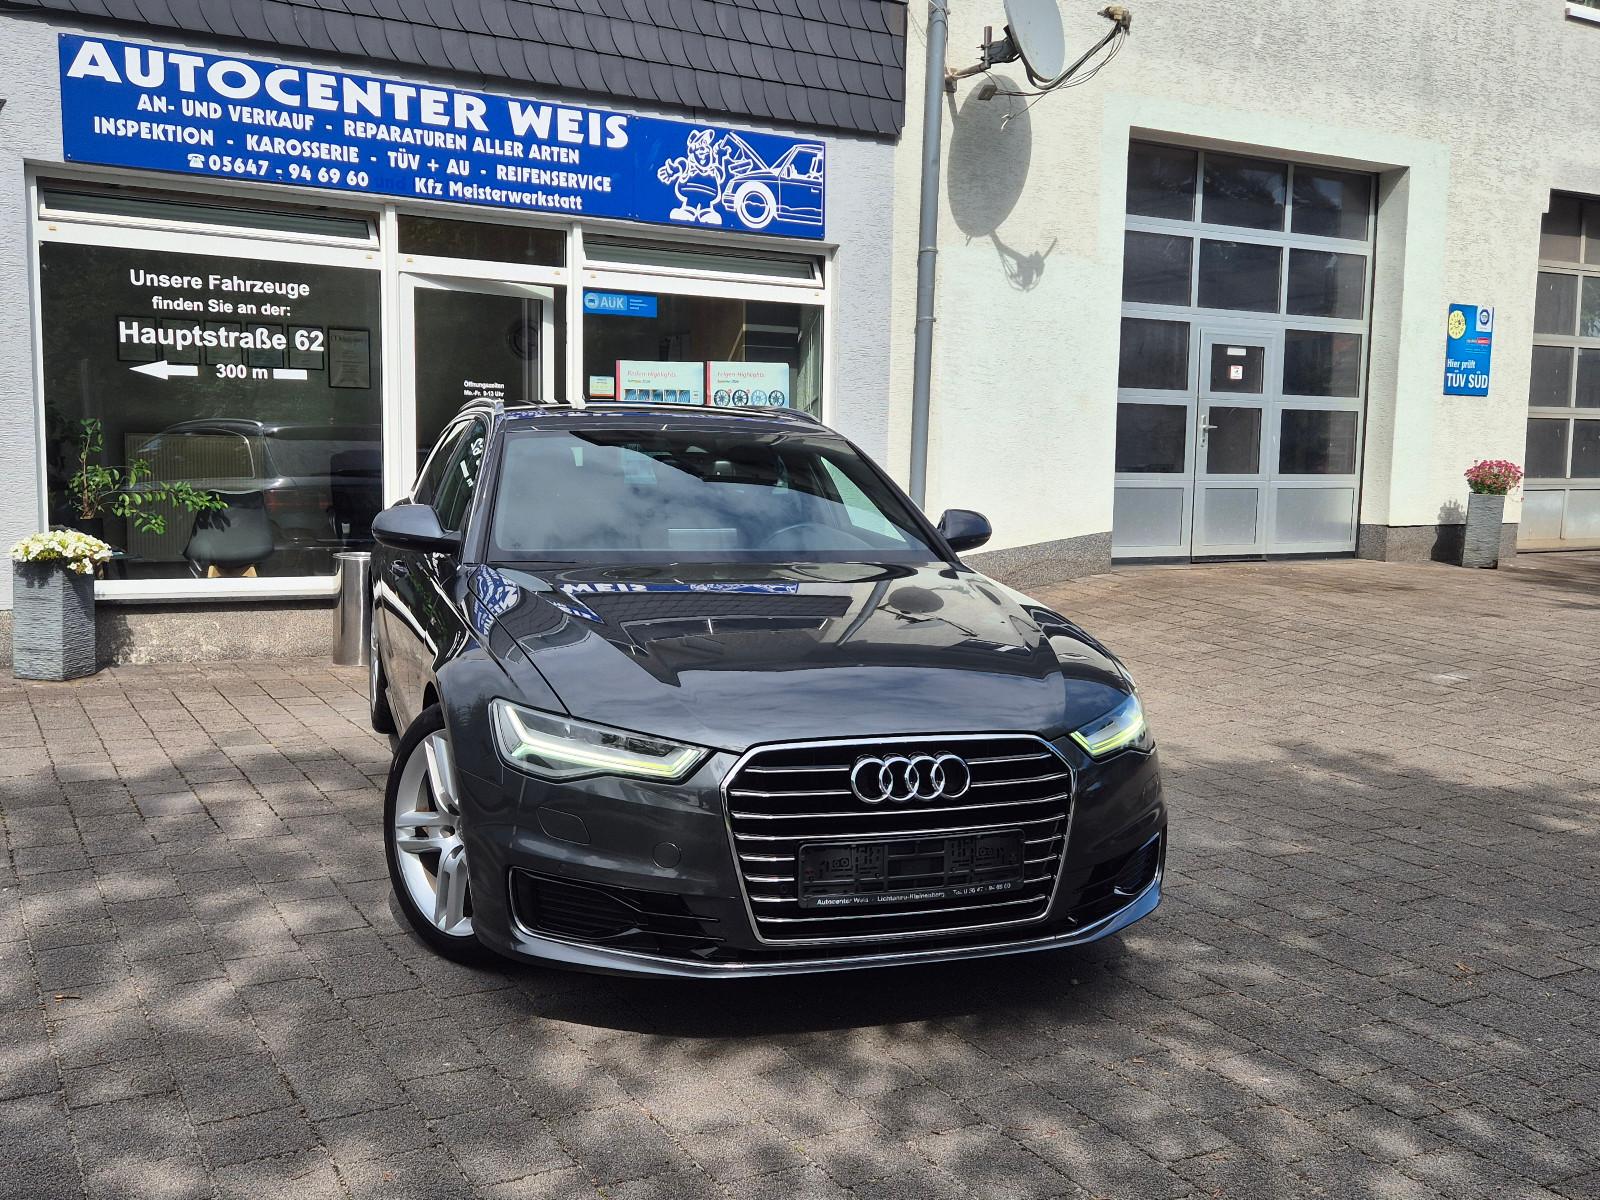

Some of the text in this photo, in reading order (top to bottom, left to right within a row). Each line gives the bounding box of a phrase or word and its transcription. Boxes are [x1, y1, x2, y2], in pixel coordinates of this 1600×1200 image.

[66, 40, 630, 148] AUTOCENTER WEIS
[137, 94, 175, 113] AN-
[182, 99, 222, 120] UND
[228, 104, 315, 131] VERKAUF
[344, 120, 466, 151] REPARATUREN
[472, 136, 524, 157] ALLER
[529, 145, 580, 165] ARTEN
[94, 116, 214, 147] INSPEKTION
[246, 134, 360, 164] KAROSSERIE
[388, 150, 421, 171] TÜV
[447, 158, 470, 176] AU
[496, 166, 612, 193] REIFENSERVICE
[208, 156, 269, 177] 05647
[289, 164, 311, 182] 94
[317, 167, 341, 185] 69
[346, 169, 369, 187] 60
[415, 178, 443, 198] Kfz
[449, 181, 583, 210] Meisterwerkstatt
[130, 269, 310, 299] Unsere Fahrzeuge
[152, 296, 291, 316] finden Sie an der:
[119, 321, 287, 350] Hauptstraße
[295, 330, 324, 351] 62
[216, 364, 268, 379] 300 m
[1446, 369, 1488, 389] TÜV SÜD
[1447, 359, 1476, 370] Hier prüft
[816, 897, 852, 906] Autocenter
